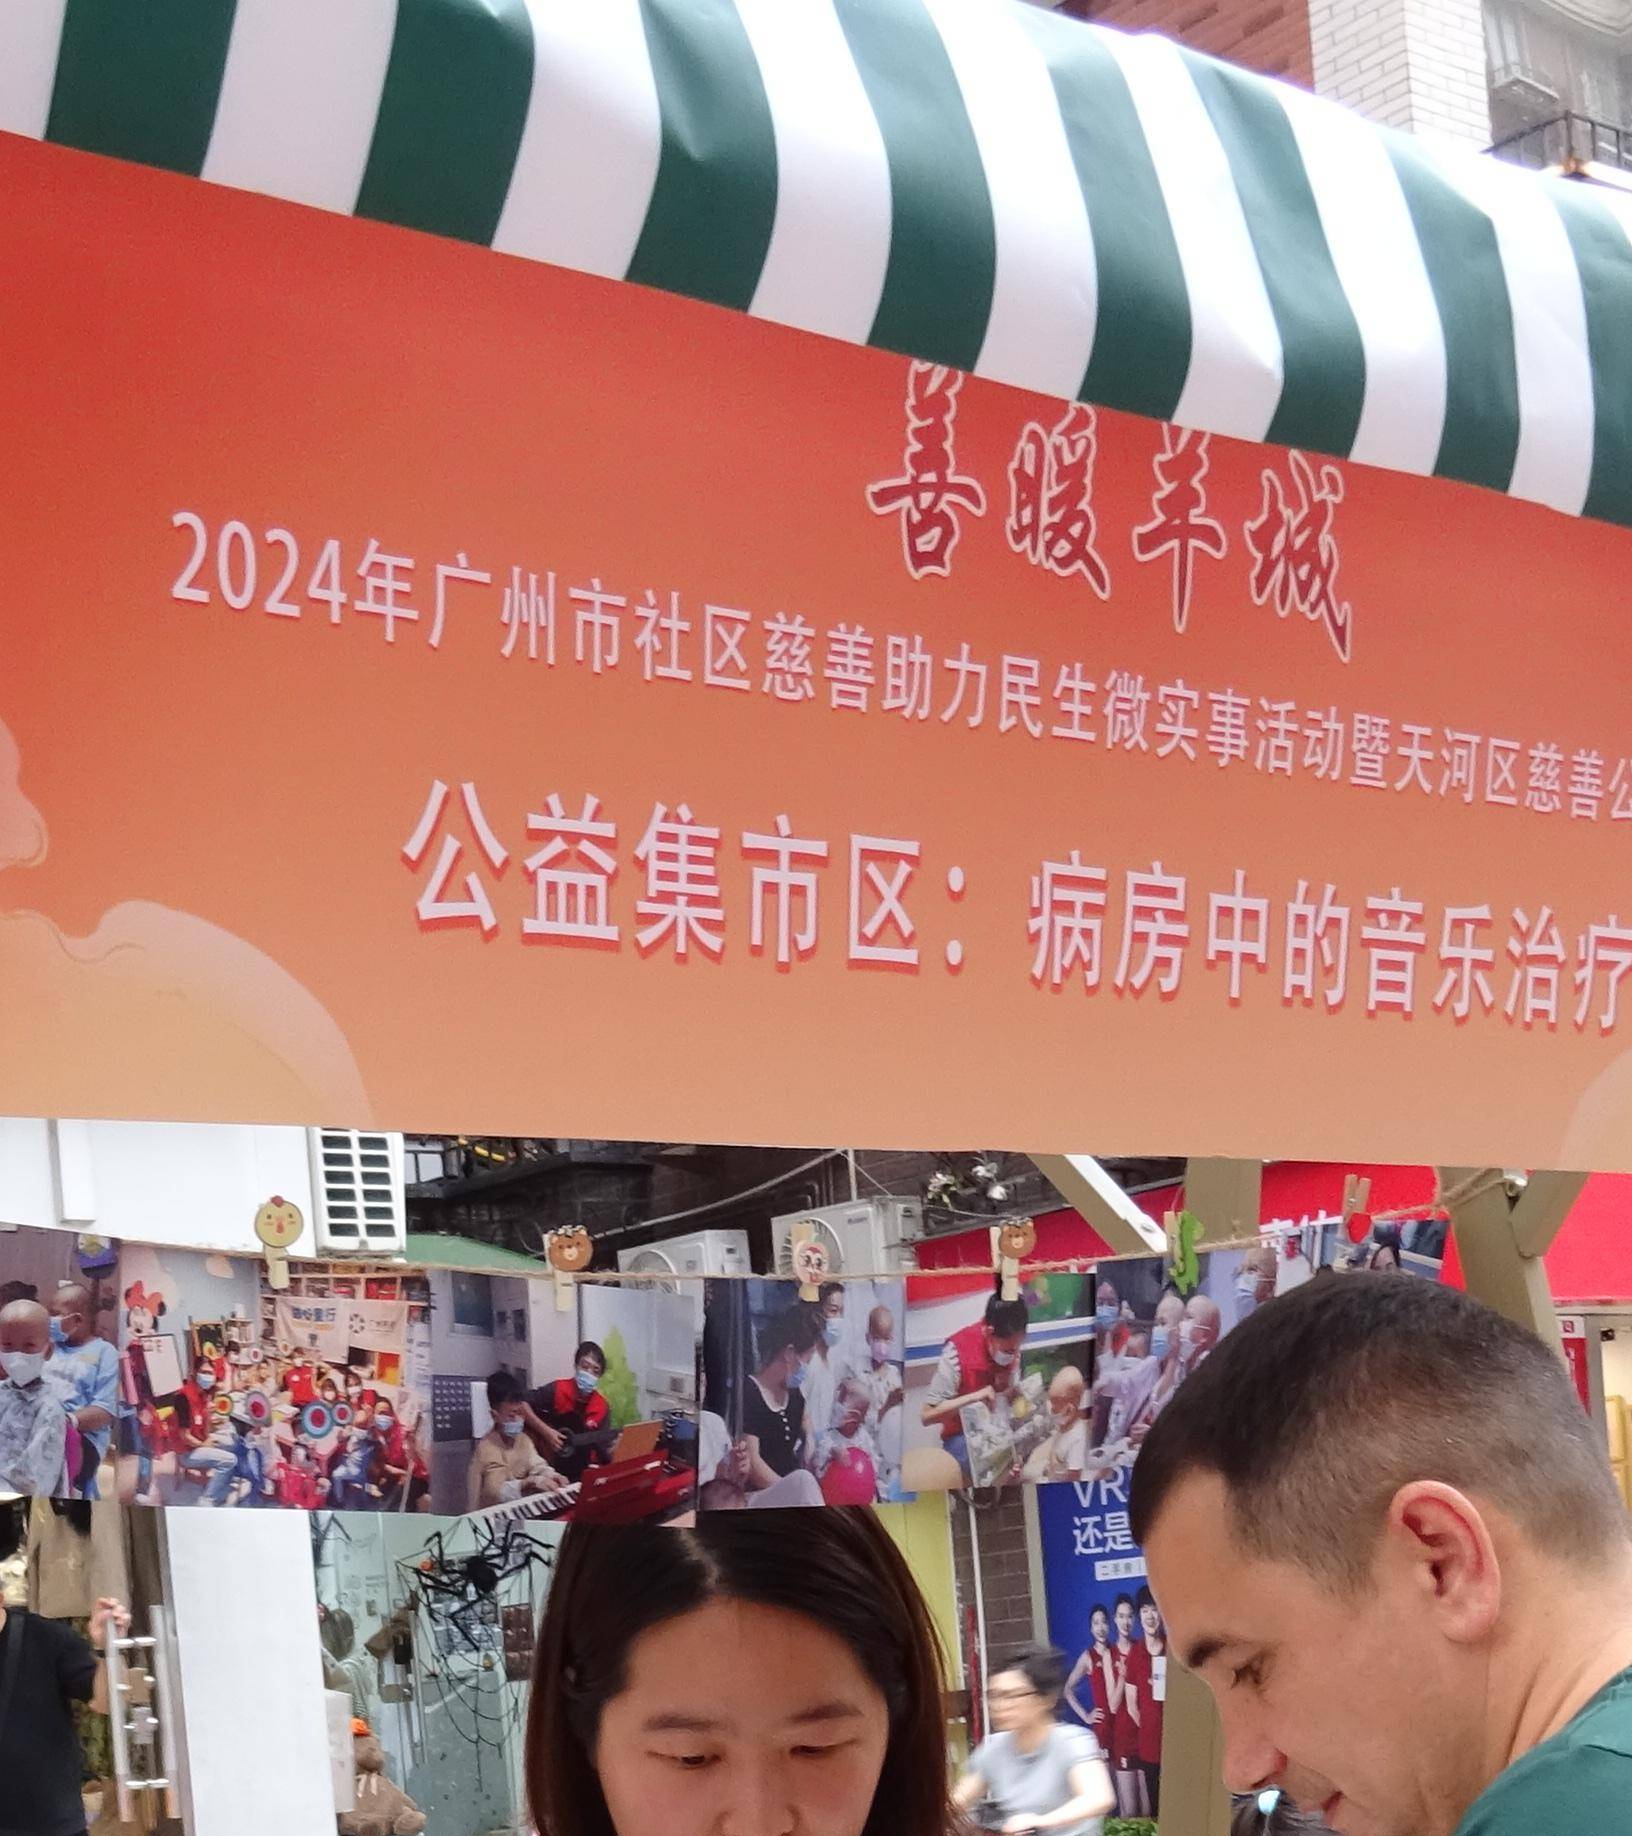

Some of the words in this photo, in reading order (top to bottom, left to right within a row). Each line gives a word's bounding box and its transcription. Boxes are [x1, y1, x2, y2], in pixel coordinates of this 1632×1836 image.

[867, 360, 1352, 662] 善暖羊城
[1072, 1464, 1131, 1508] VR
